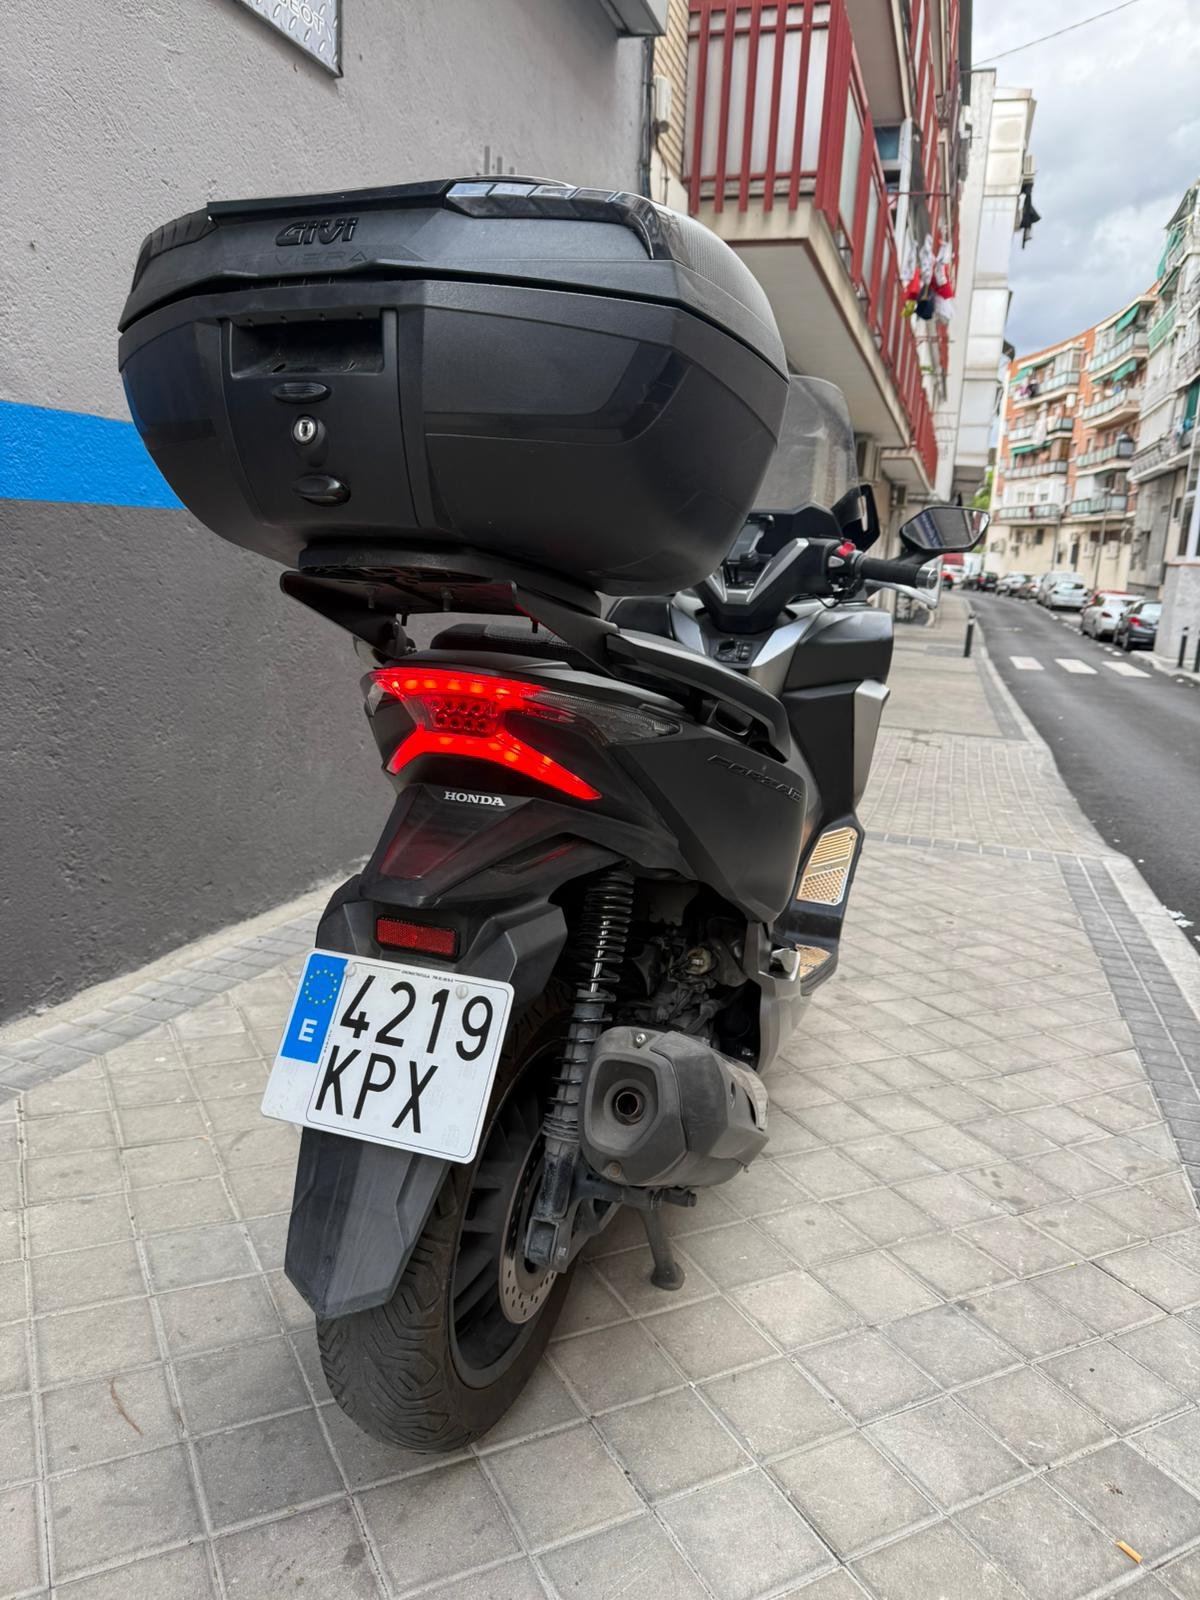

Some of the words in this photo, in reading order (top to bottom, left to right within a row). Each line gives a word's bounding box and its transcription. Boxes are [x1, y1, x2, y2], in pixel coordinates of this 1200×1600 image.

[443, 791, 506, 806] HONDA
[298, 1018, 318, 1042] E
[340, 975, 494, 1061] 4219
[315, 1045, 439, 1133] KPX
